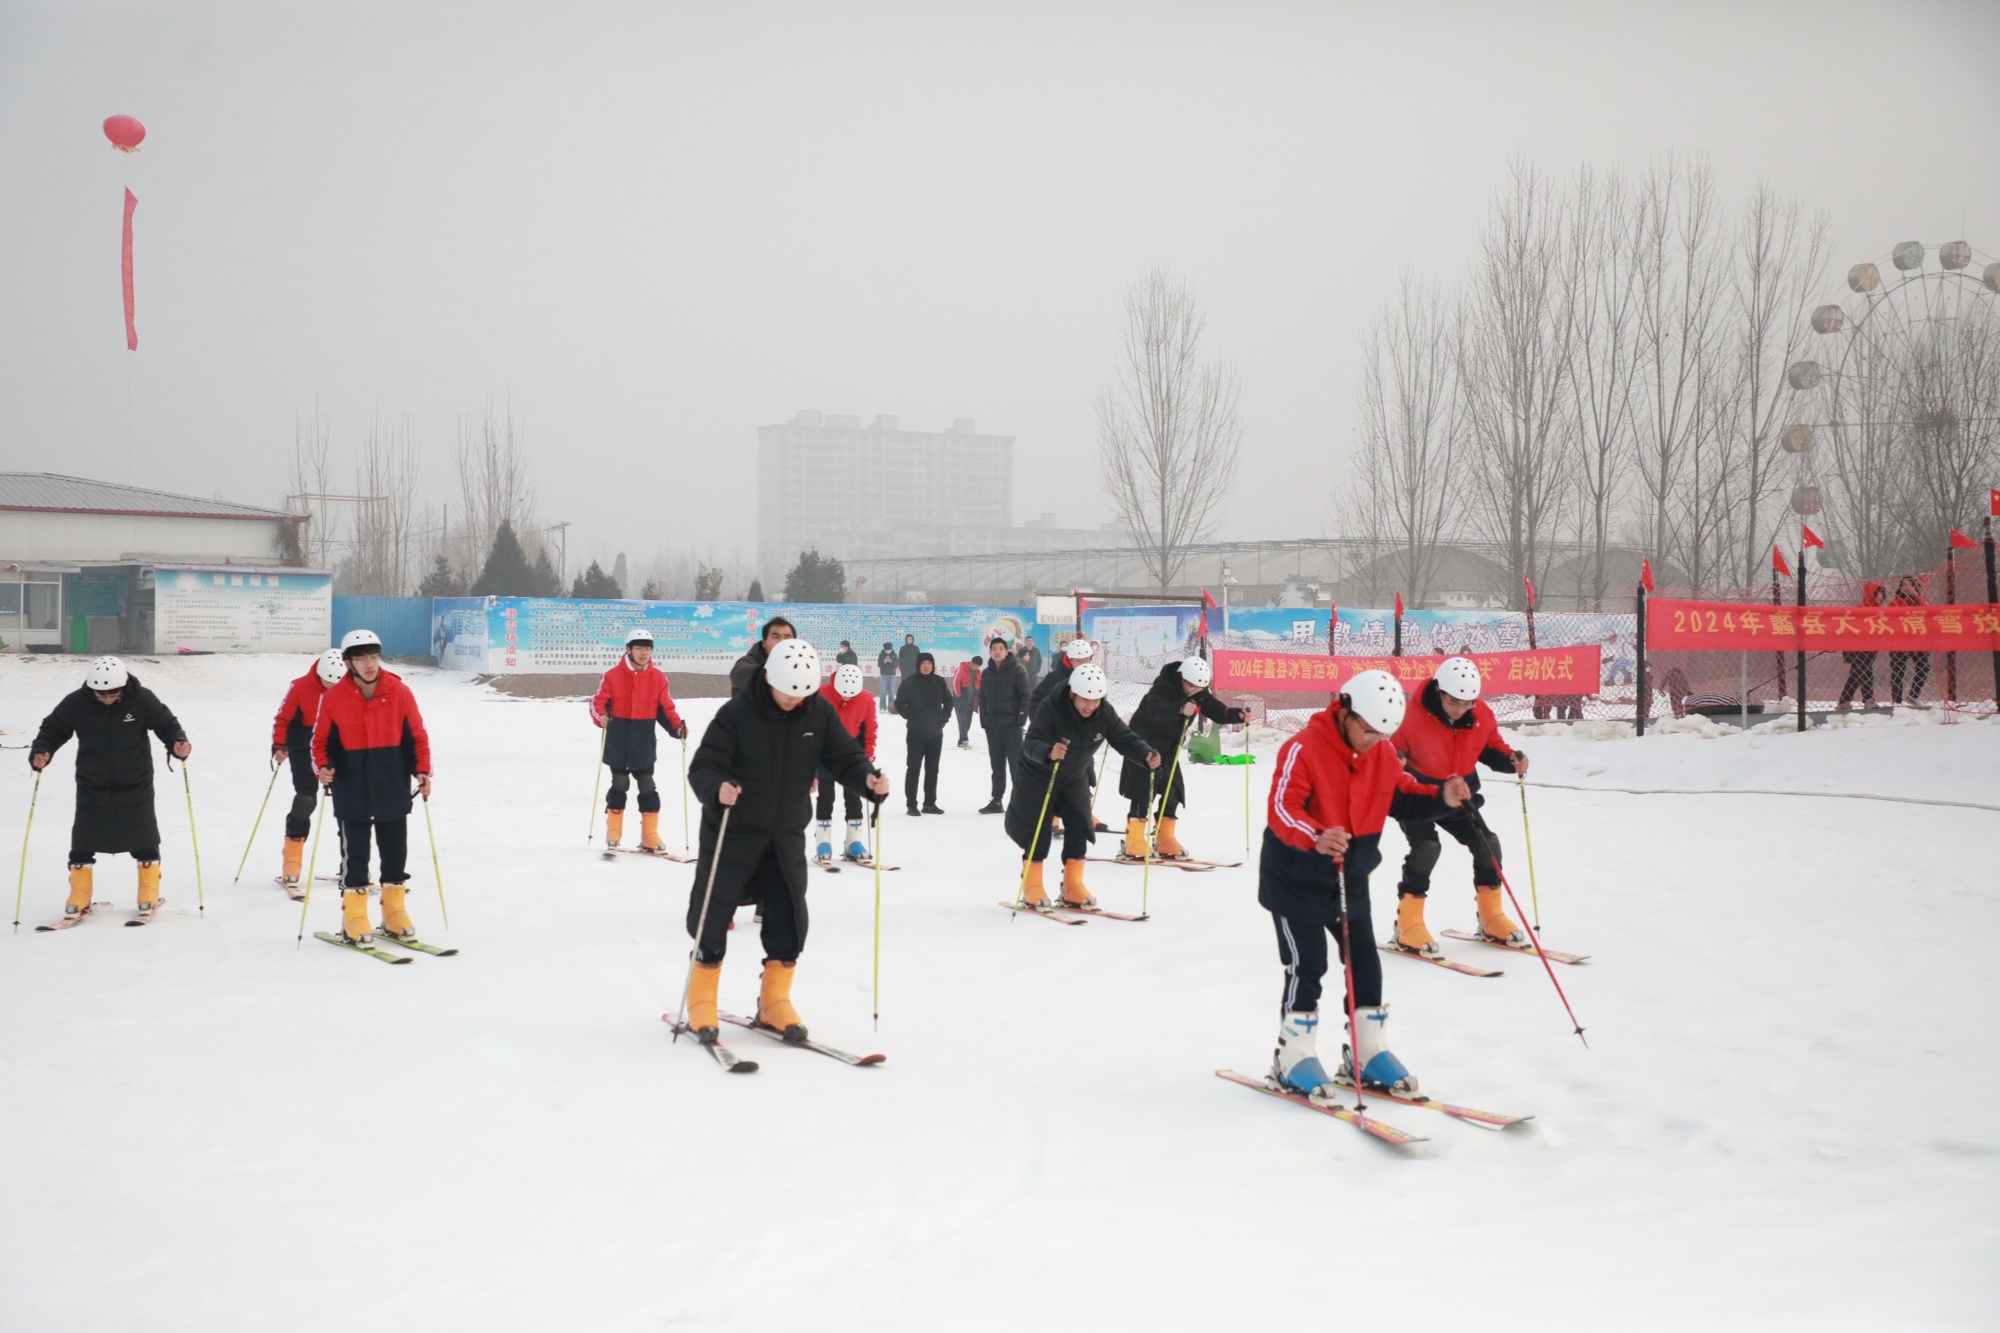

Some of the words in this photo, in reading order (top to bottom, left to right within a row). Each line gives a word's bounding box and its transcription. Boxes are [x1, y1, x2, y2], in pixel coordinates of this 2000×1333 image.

[505, 608, 517, 667] 滑雪场须知
[1508, 655, 1574, 680] 启动仪式
